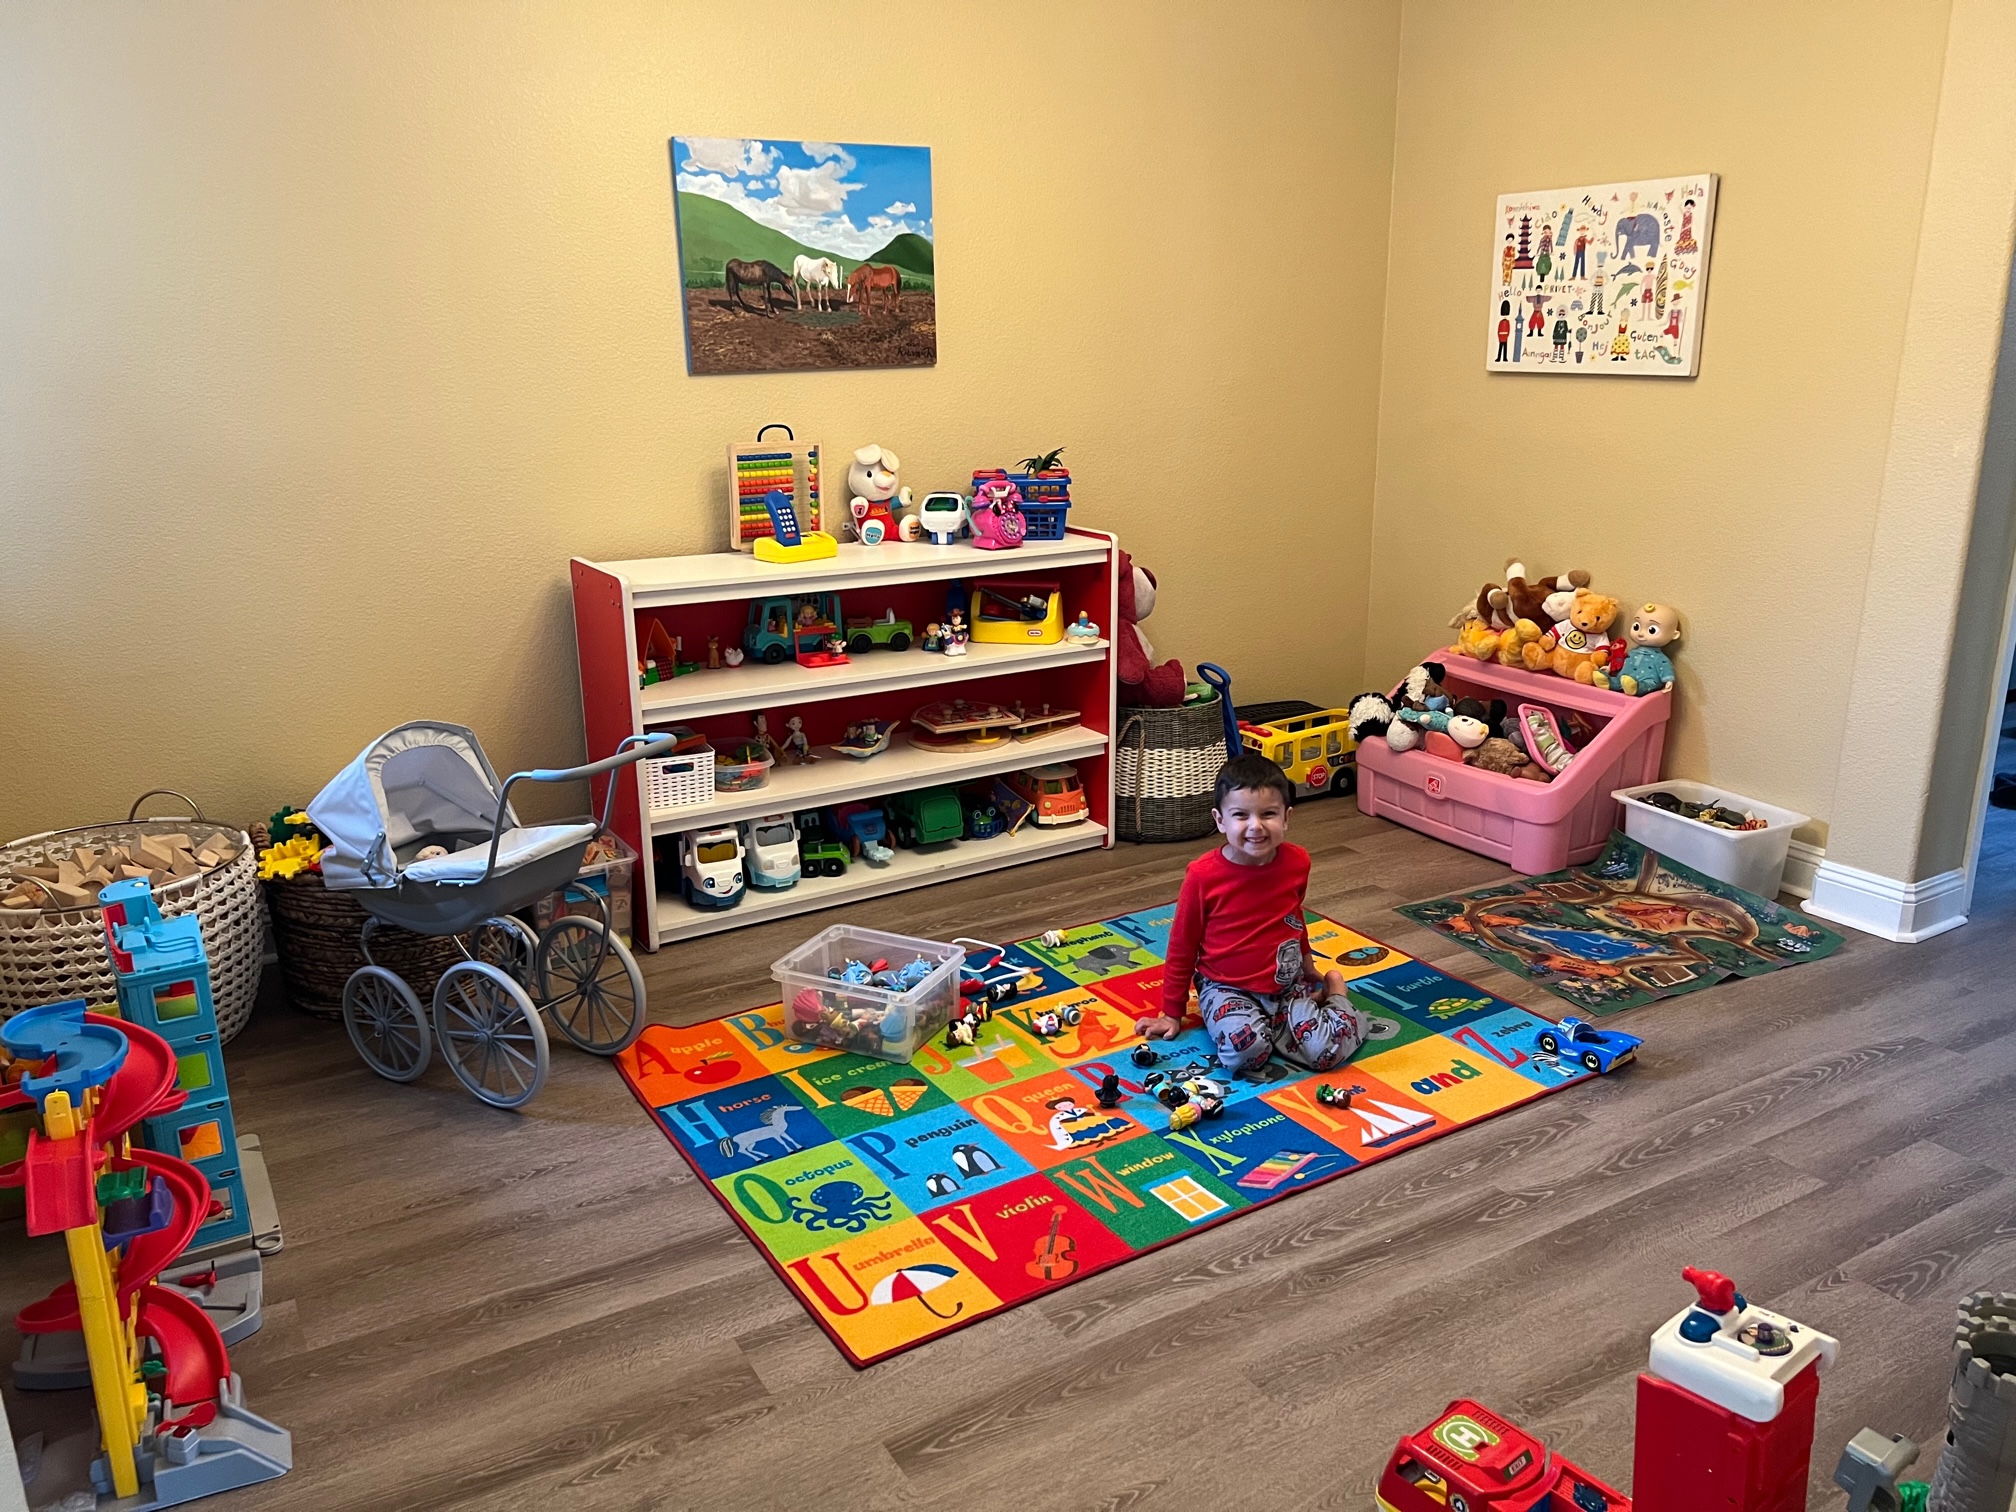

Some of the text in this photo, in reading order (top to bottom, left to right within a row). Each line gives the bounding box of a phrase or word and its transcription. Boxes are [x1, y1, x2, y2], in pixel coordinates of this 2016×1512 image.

[1581, 194, 1608, 226] Howdy
[1680, 184, 1704, 199] Hola
[1497, 287, 1522, 301] Hello
[1313, 772, 1326, 781] STOP
[1106, 916, 1156, 945] F
[1018, 939, 1079, 967] E
[1087, 982, 1157, 1015] L
[1345, 973, 1443, 1011] T turtle
[724, 1013, 785, 1051] B
[997, 1007, 1069, 1046] K
[1452, 1020, 1534, 1069] Z zebra
[634, 1037, 724, 1080] A apple
[1410, 1058, 1484, 1097] and
[782, 1067, 837, 1110] I
[811, 1073, 843, 1087] ice
[989, 1081, 1075, 1136] Q queen
[1265, 1085, 1349, 1132] Y
[659, 1092, 772, 1149] H horse
[844, 1118, 980, 1181] P penguin
[1163, 1114, 1287, 1177] X xylophone
[733, 1158, 854, 1225] O octopus
[1053, 1150, 1176, 1215] W window
[931, 1193, 1054, 1263] V violin
[787, 1235, 937, 1316] U umbrella
[1510, 1456, 1527, 1474] EXIT
